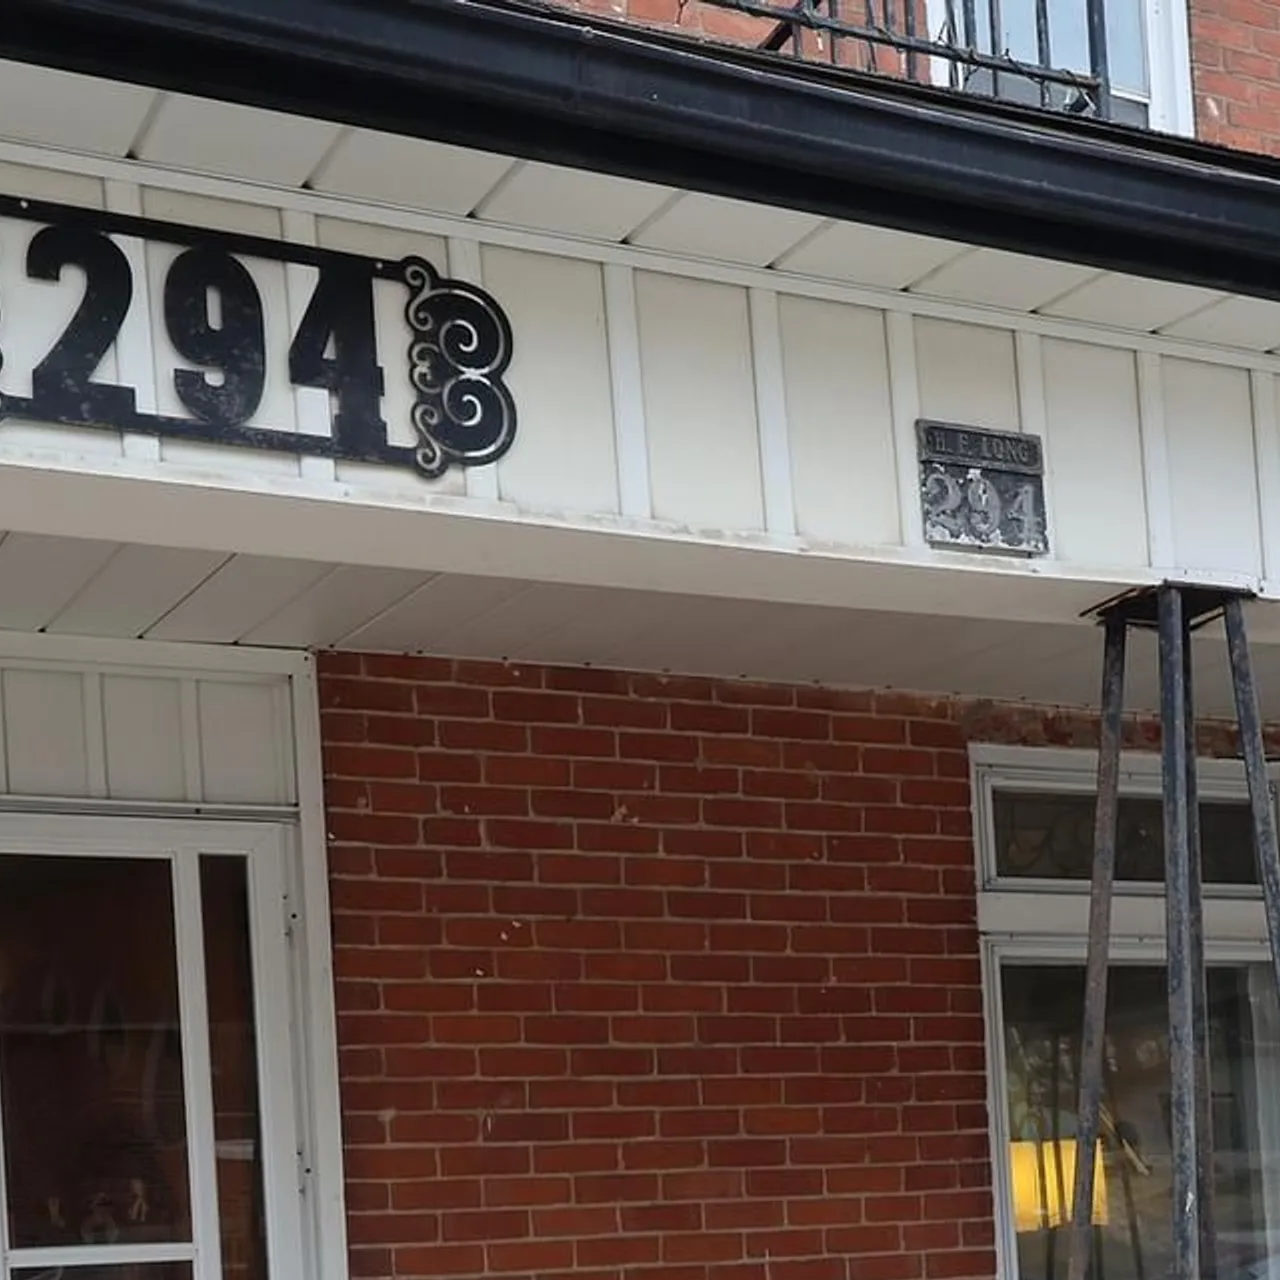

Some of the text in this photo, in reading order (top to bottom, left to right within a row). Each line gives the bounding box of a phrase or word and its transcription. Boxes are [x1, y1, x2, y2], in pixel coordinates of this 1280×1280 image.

[25, 222, 388, 462] 294
[981, 437, 1029, 462] LONG
[924, 474, 1043, 545] 294
